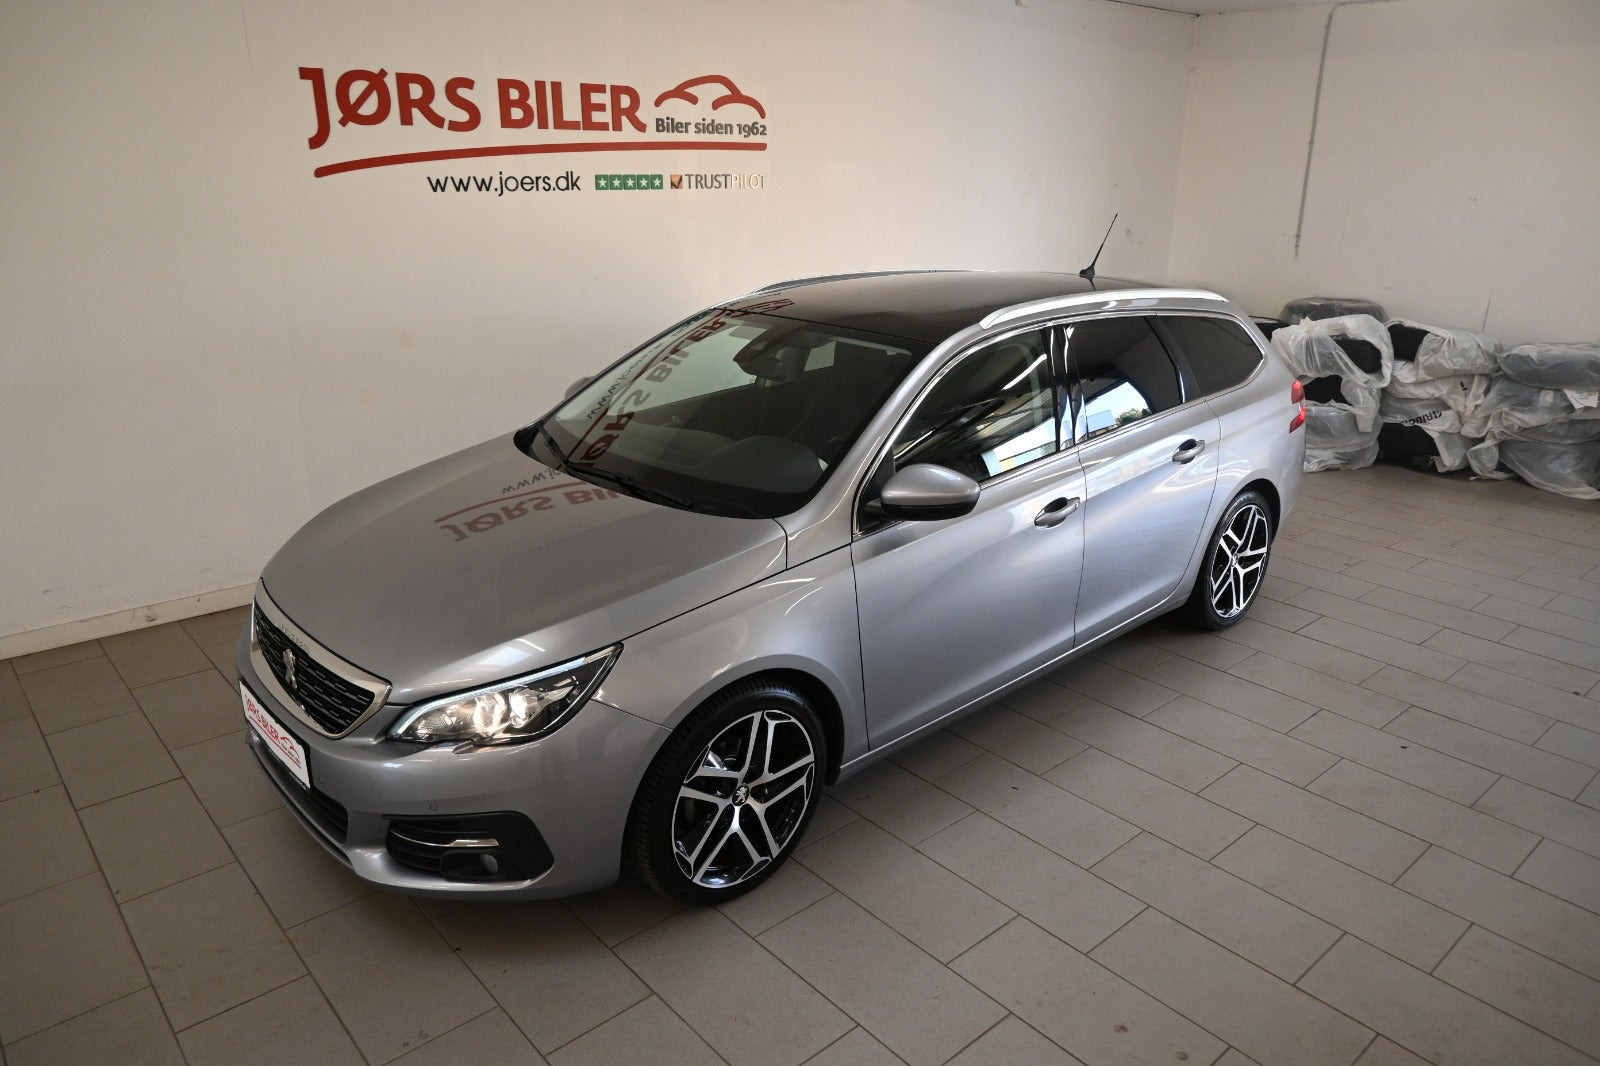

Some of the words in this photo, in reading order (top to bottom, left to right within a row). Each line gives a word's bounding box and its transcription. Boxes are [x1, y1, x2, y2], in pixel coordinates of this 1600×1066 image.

[298, 66, 482, 150] JØRS
[497, 77, 647, 133] BILER
[655, 116, 692, 134] Biler
[694, 117, 734, 135] siden
[736, 121, 768, 138] 1962
[426, 170, 581, 197] www.joers.dk
